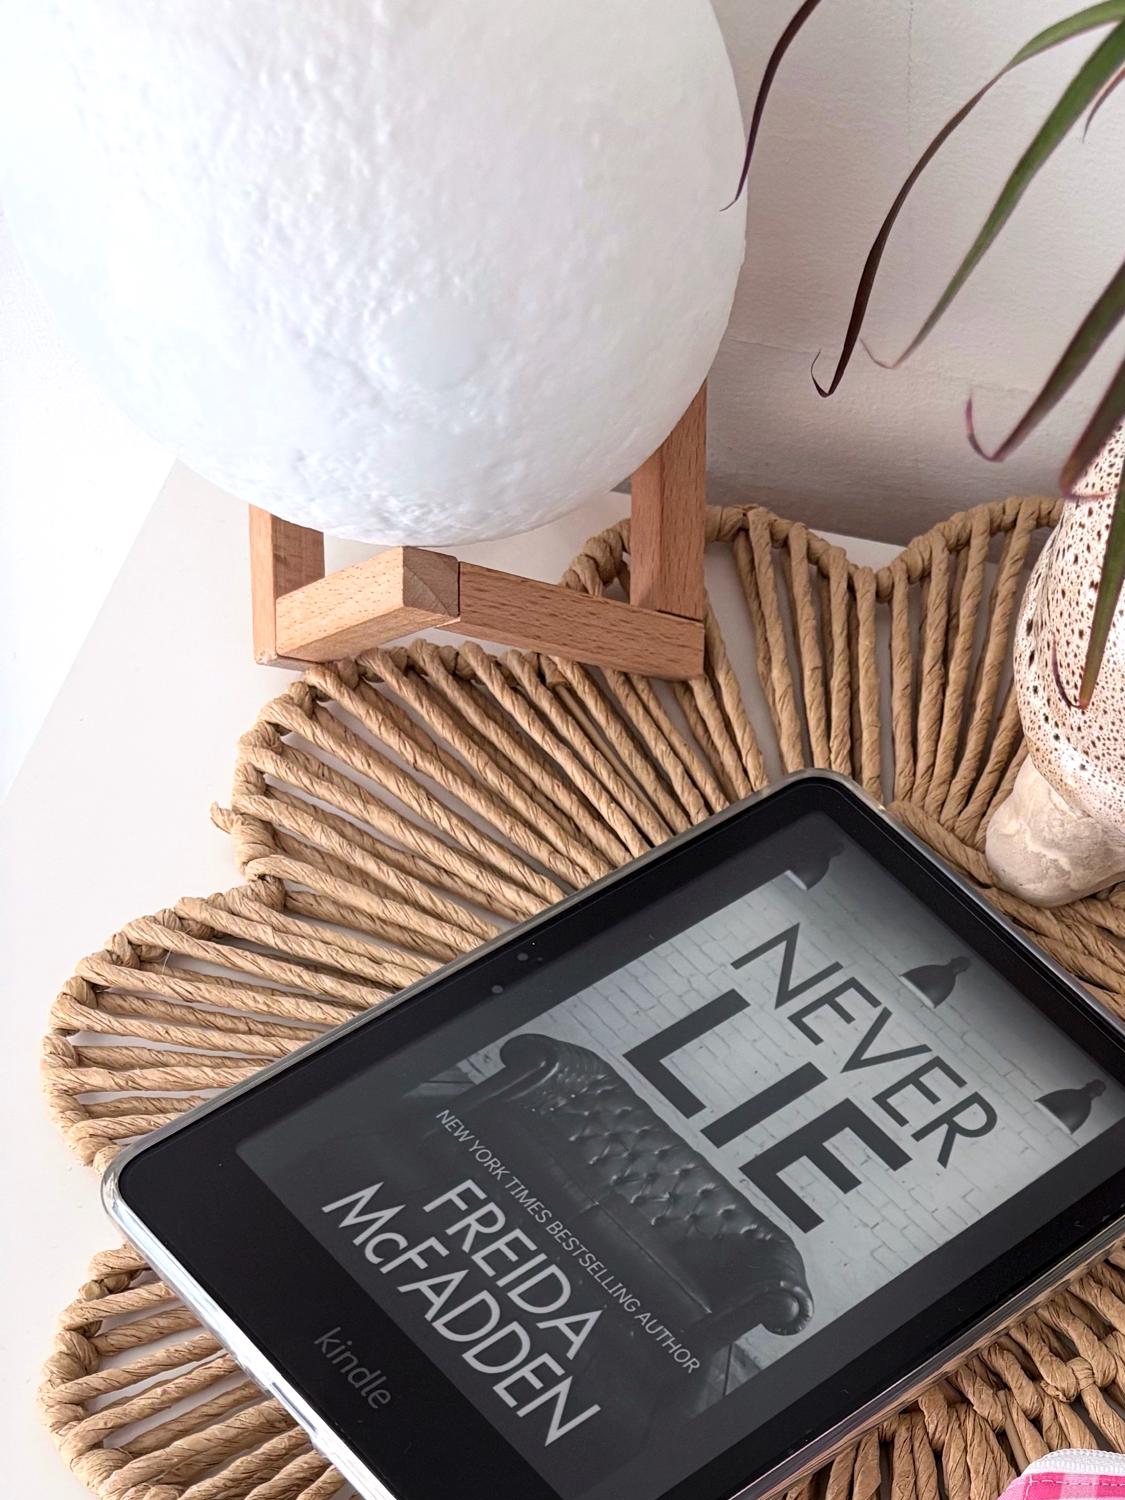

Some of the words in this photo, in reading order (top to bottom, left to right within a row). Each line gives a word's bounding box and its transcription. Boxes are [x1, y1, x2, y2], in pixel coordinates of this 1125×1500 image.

[622, 988, 913, 1234] LIE
[730, 922, 998, 1169] NEVER
[321, 1181, 601, 1447] McFADDEN
[423, 1178, 603, 1361] FREIDA
[436, 1109, 474, 1143] NEW
[470, 1140, 510, 1181] YORK
[505, 1176, 552, 1224] TIMES
[546, 1220, 641, 1312] BESTSELLING
[635, 1311, 701, 1374] AUTHOR
[313, 1326, 392, 1409] kindle
